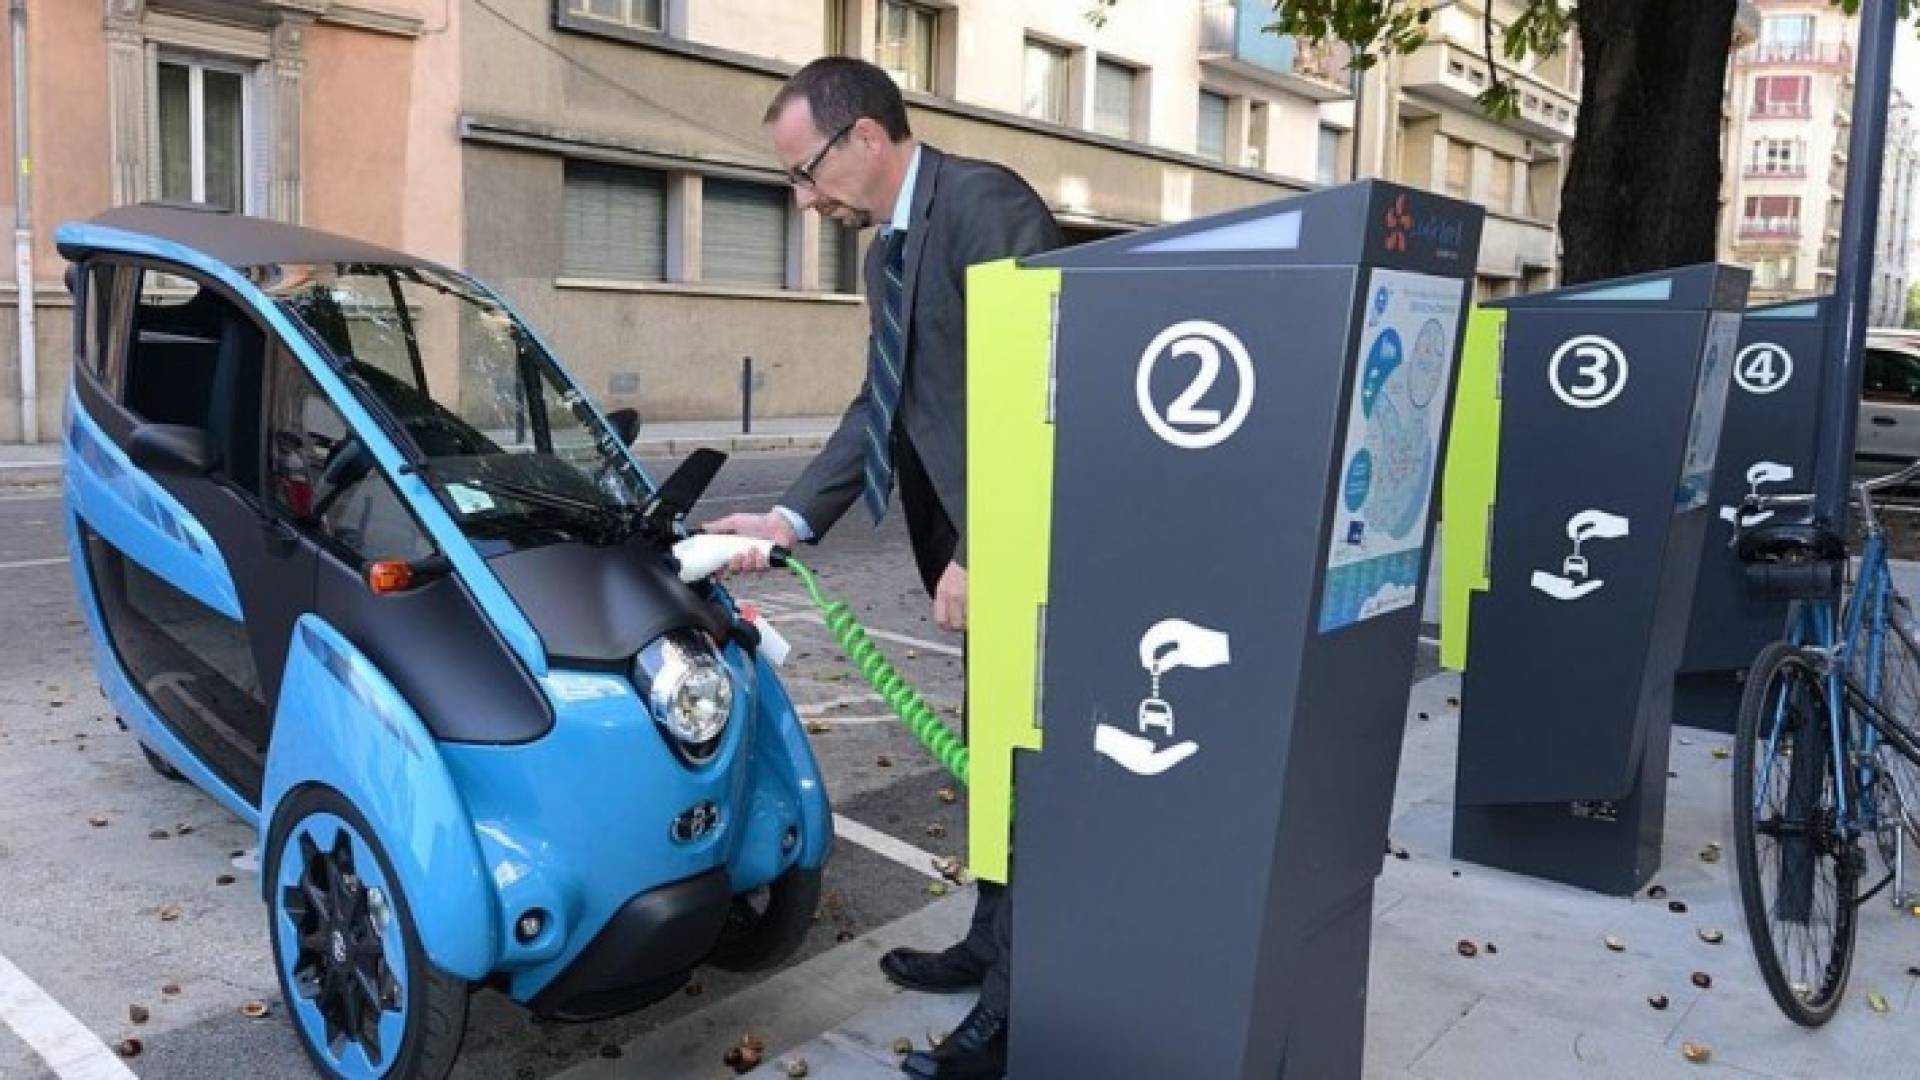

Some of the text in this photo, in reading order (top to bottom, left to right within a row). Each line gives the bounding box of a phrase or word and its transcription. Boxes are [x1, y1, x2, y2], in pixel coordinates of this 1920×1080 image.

[1166, 337, 1221, 424] 2
[1571, 347, 1609, 395] 3
[1744, 350, 1776, 385] 4
